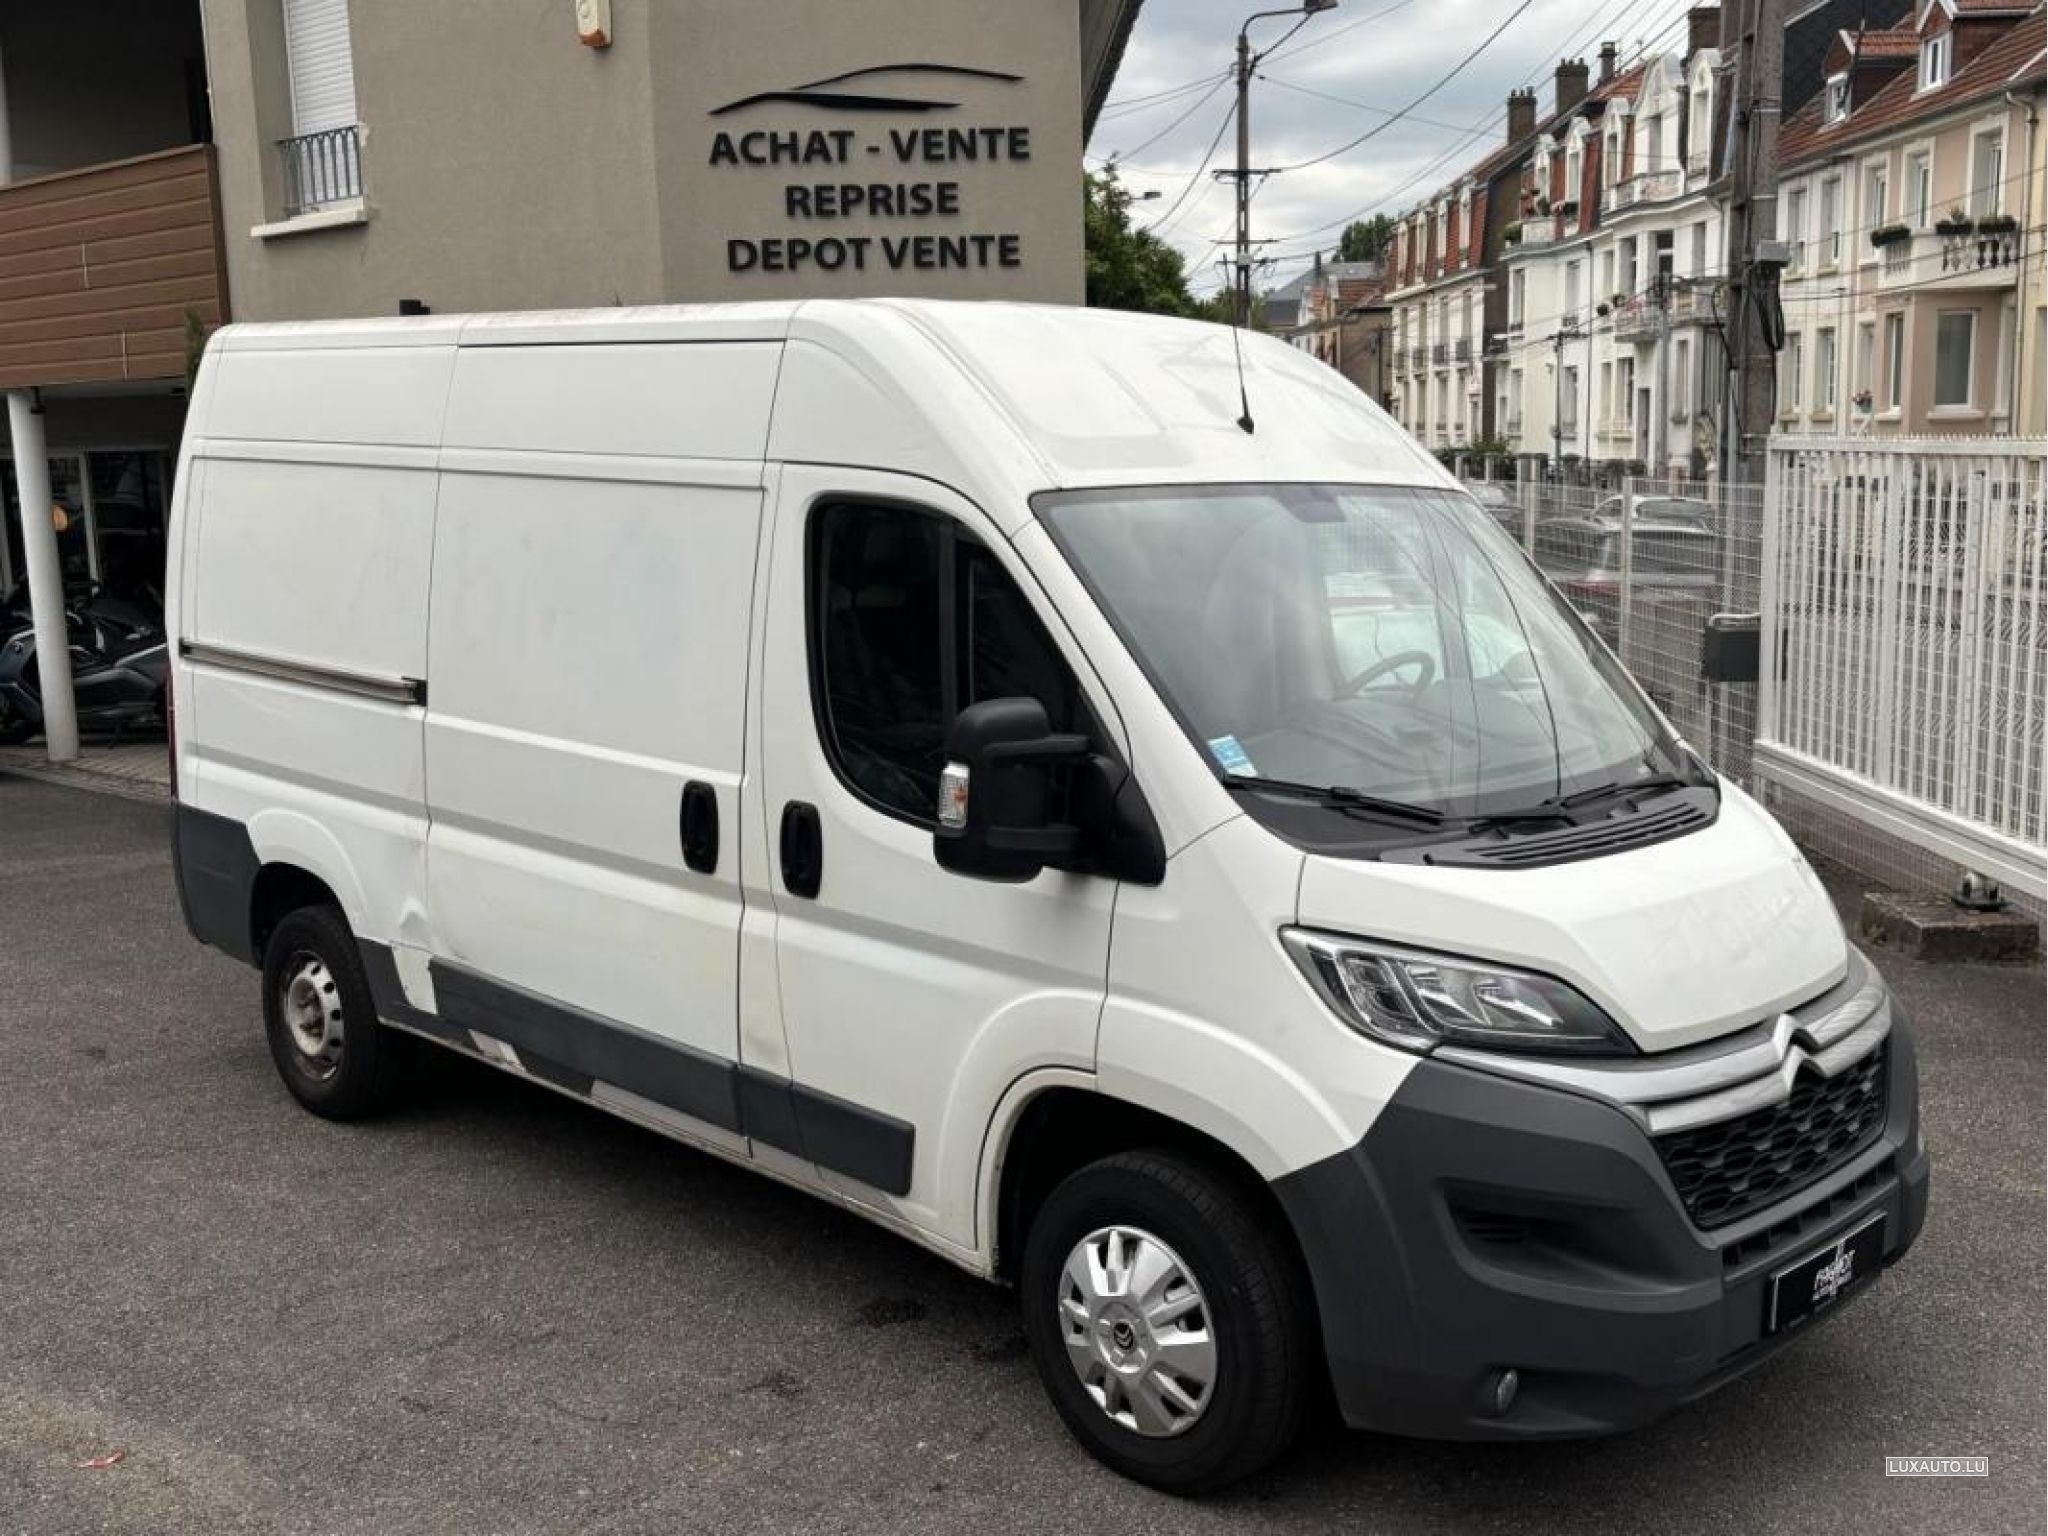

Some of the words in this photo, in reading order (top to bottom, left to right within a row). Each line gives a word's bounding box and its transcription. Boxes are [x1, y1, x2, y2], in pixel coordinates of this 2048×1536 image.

[709, 130, 855, 164] ACHAT
[866, 145, 880, 153] -
[890, 127, 1030, 162] VENTE
[786, 182, 960, 217] REPRISE
[727, 237, 871, 271] DEPOT
[880, 235, 1021, 268] VENTE
